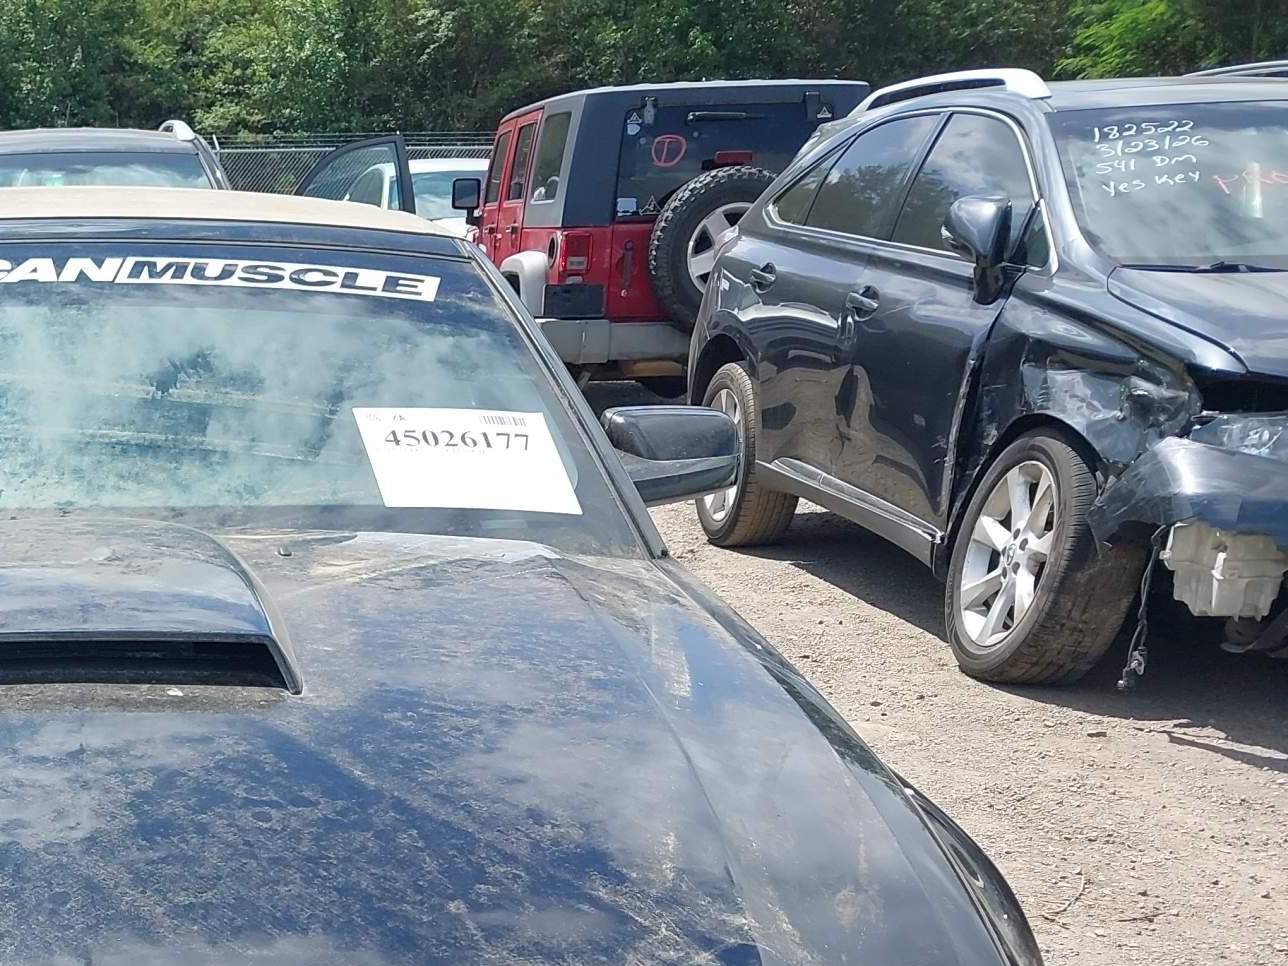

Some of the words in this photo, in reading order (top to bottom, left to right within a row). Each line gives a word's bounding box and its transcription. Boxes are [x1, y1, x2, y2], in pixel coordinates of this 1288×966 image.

[1094, 120, 1194, 142] 182522
[1096, 159, 1135, 174] 541
[384, 429, 530, 450] 45026177
